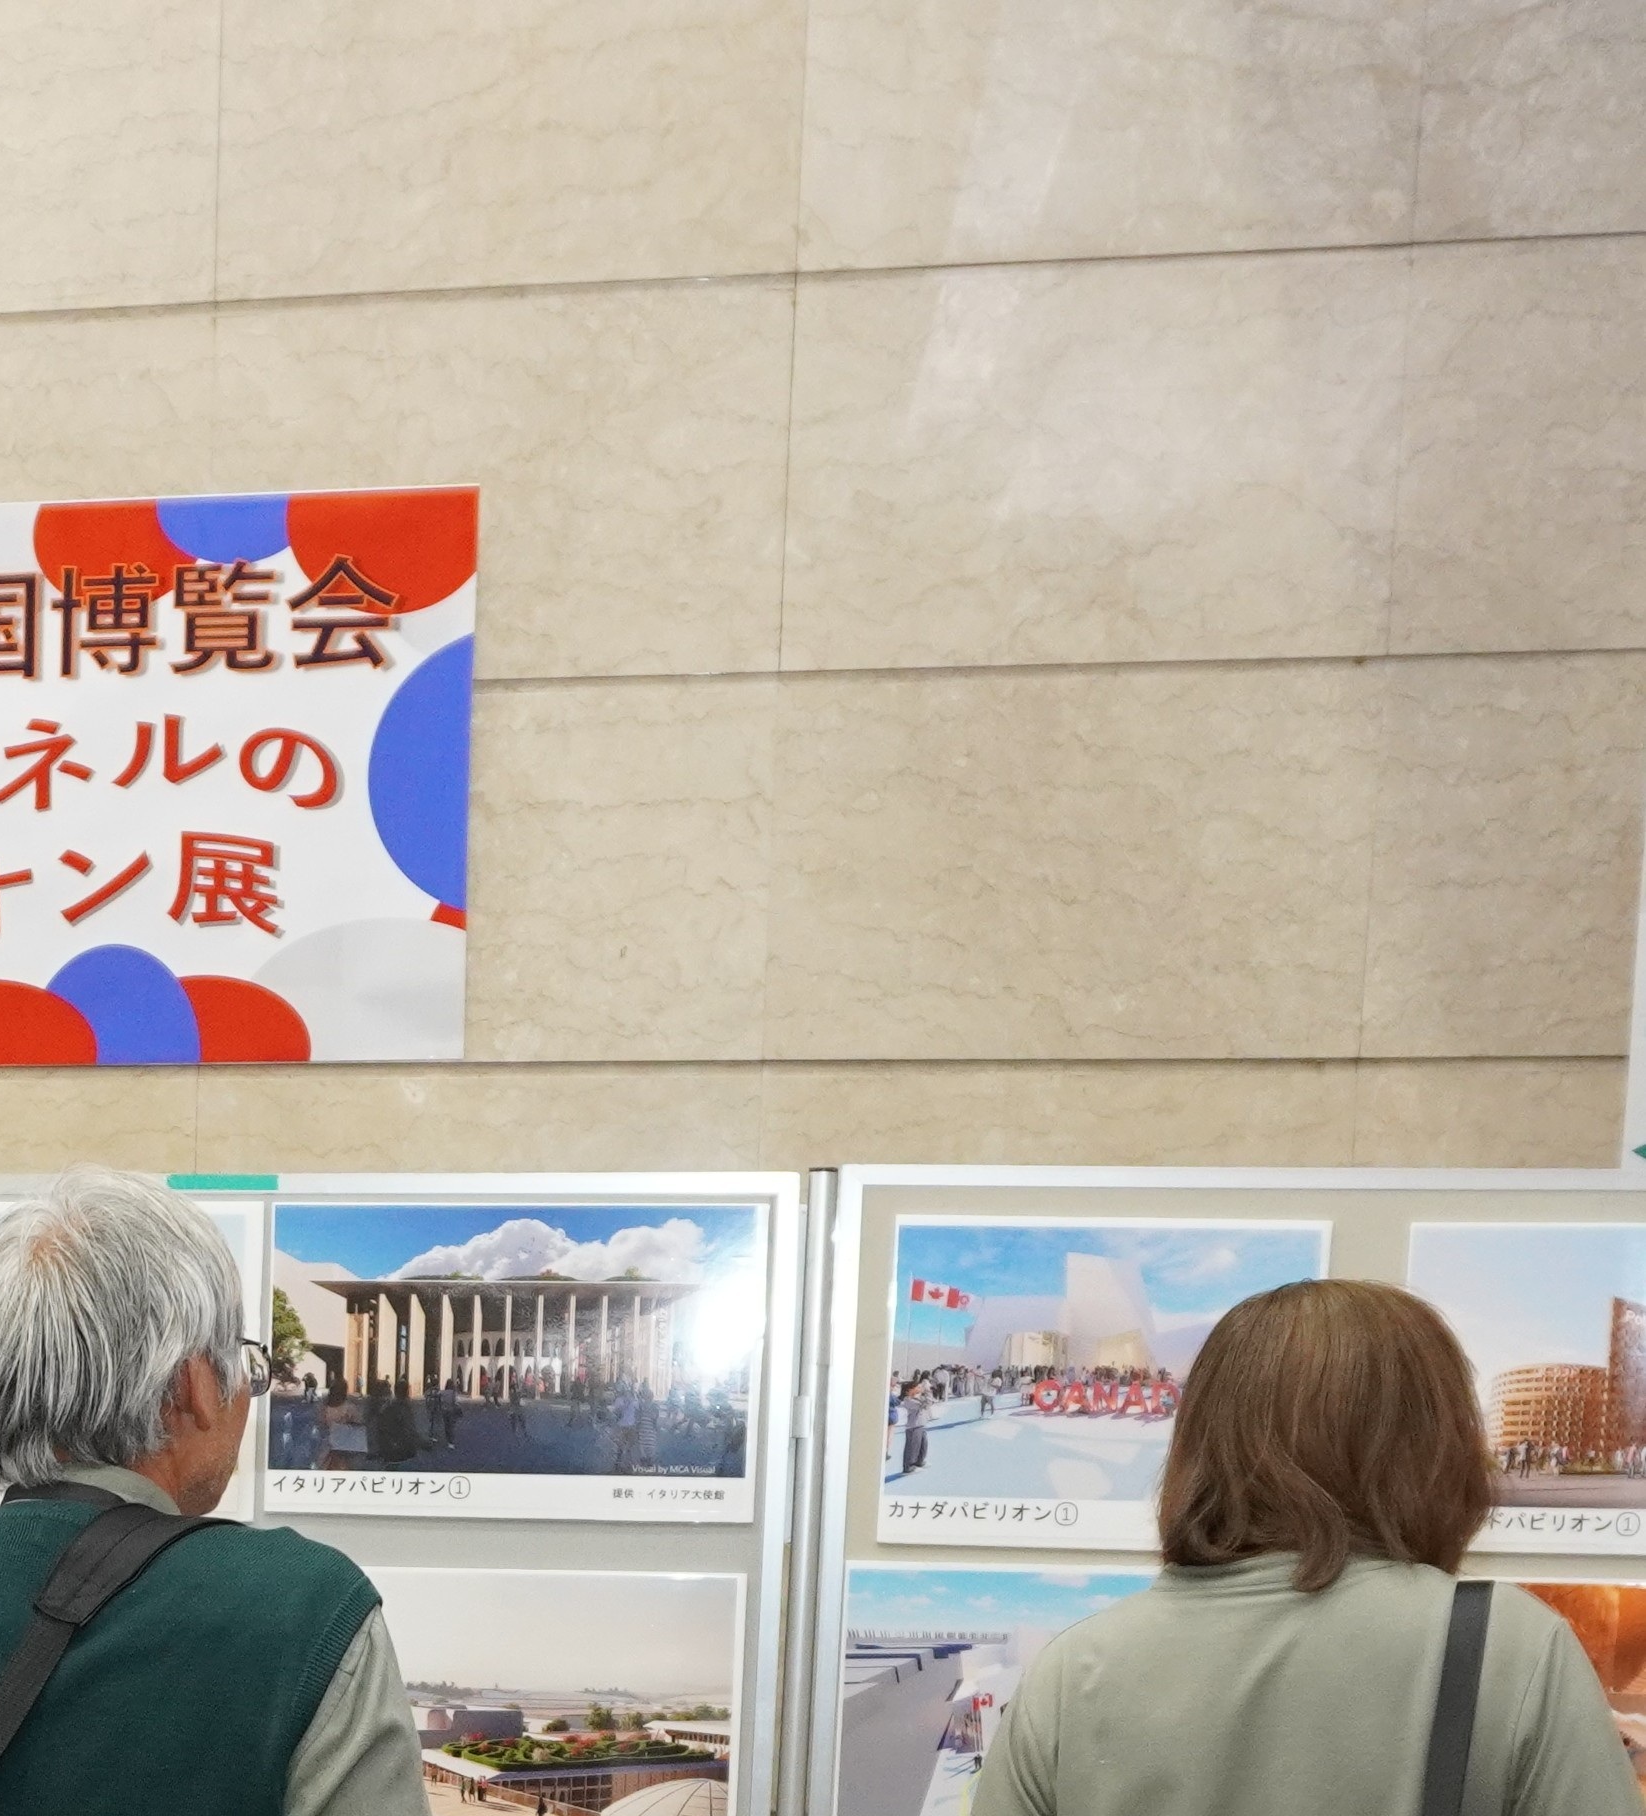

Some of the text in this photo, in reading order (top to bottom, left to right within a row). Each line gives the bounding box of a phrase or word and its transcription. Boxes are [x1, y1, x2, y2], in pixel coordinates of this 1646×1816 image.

[271, 1473, 472, 1500] イタリアパビリオン①
[887, 1499, 1079, 1527] カナダパビリオン①
